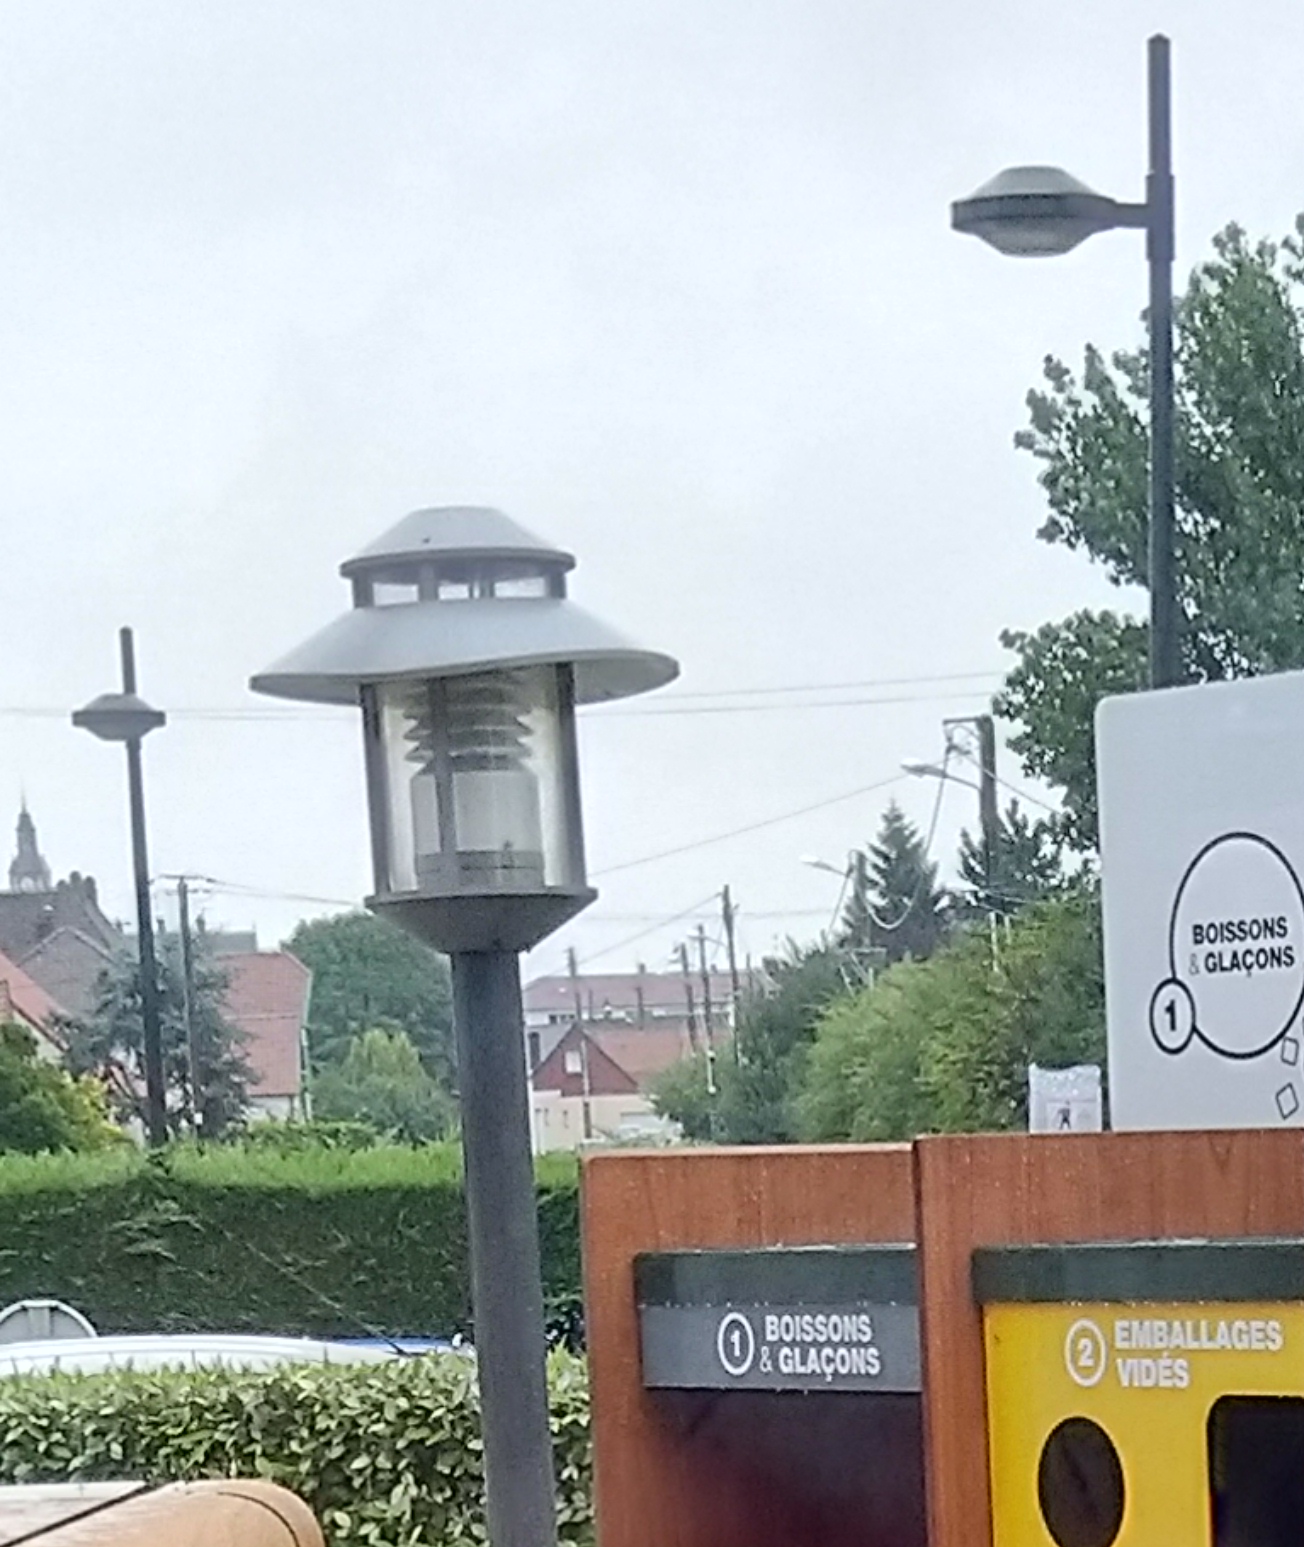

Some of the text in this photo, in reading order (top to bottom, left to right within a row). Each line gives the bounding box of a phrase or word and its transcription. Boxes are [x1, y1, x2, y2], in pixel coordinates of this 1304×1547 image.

[1192, 916, 1289, 945] BOISSONS
[1188, 945, 1295, 977] & GLAÇONS
[1164, 1000, 1179, 1031] 1
[729, 1331, 743, 1356] 1
[764, 1314, 873, 1343] BOISSONS
[1114, 1320, 1284, 1351] EMBALLAGES
[759, 1346, 881, 1379] & GLAÇONS
[1077, 1340, 1093, 1366] 2
[1116, 1354, 1190, 1388] VIDÉS
